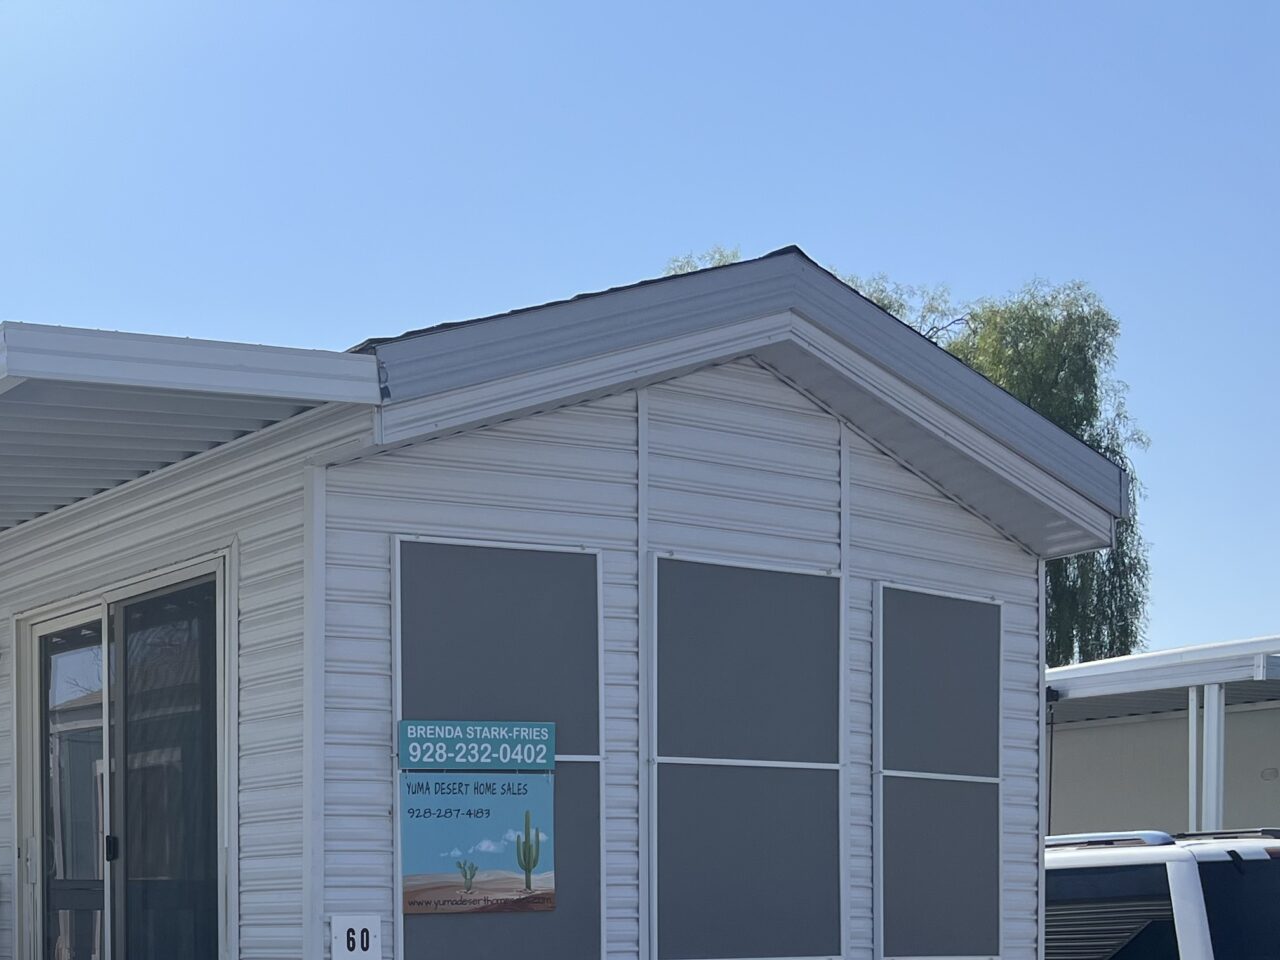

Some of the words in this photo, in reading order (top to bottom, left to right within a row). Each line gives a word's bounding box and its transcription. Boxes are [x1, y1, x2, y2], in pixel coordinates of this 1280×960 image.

[407, 725, 463, 739] BRENDA
[466, 726, 549, 740] STARK-FRIES
[408, 742, 547, 763] 928-232-0402
[406, 781, 431, 796] YUMA
[434, 782, 470, 796] DESERT
[473, 782, 497, 796] HOME
[500, 782, 528, 796] SALES
[407, 807, 491, 819] 928-287-4183
[346, 927, 370, 952] 60
